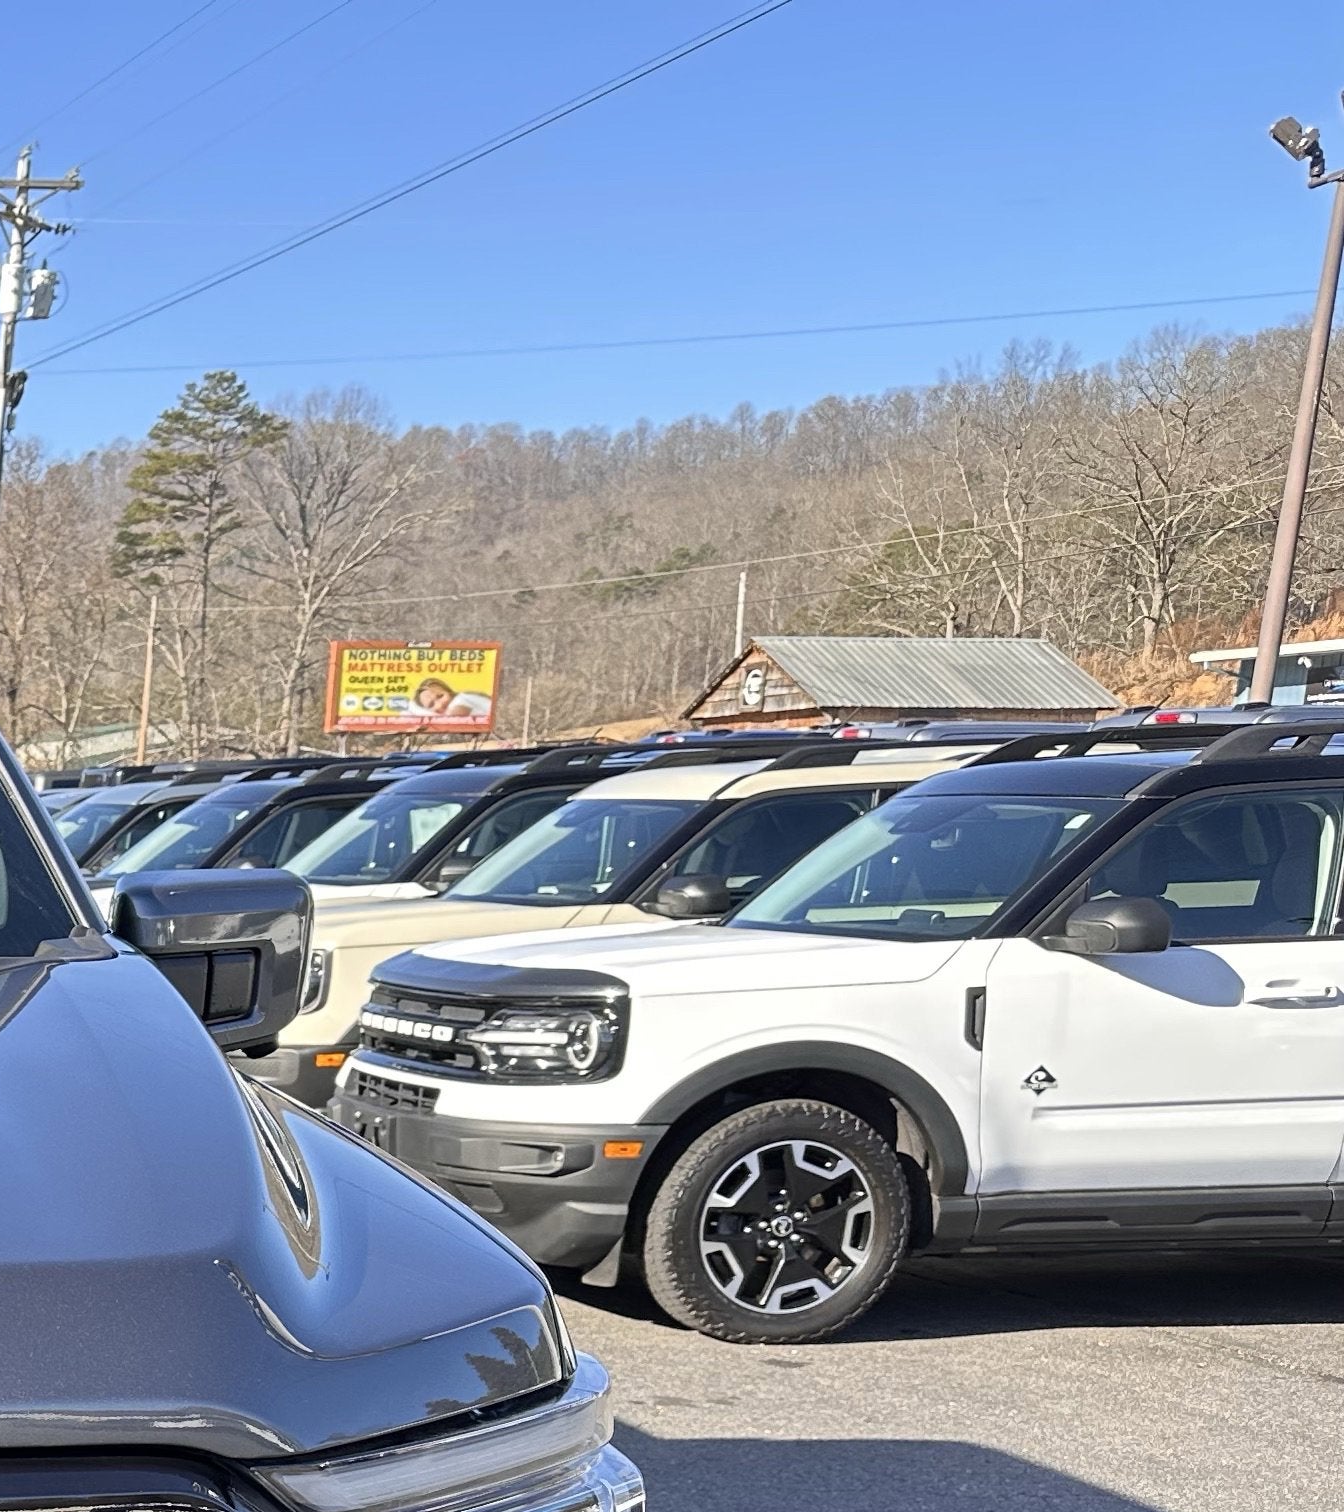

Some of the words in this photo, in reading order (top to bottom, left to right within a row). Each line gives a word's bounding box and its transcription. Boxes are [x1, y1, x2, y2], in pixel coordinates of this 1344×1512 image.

[348, 650, 412, 661] NOTHING
[417, 650, 445, 661] BUY
[450, 651, 486, 662] BEDS
[346, 662, 422, 673] MATTRESS
[428, 662, 484, 673] OUTLET
